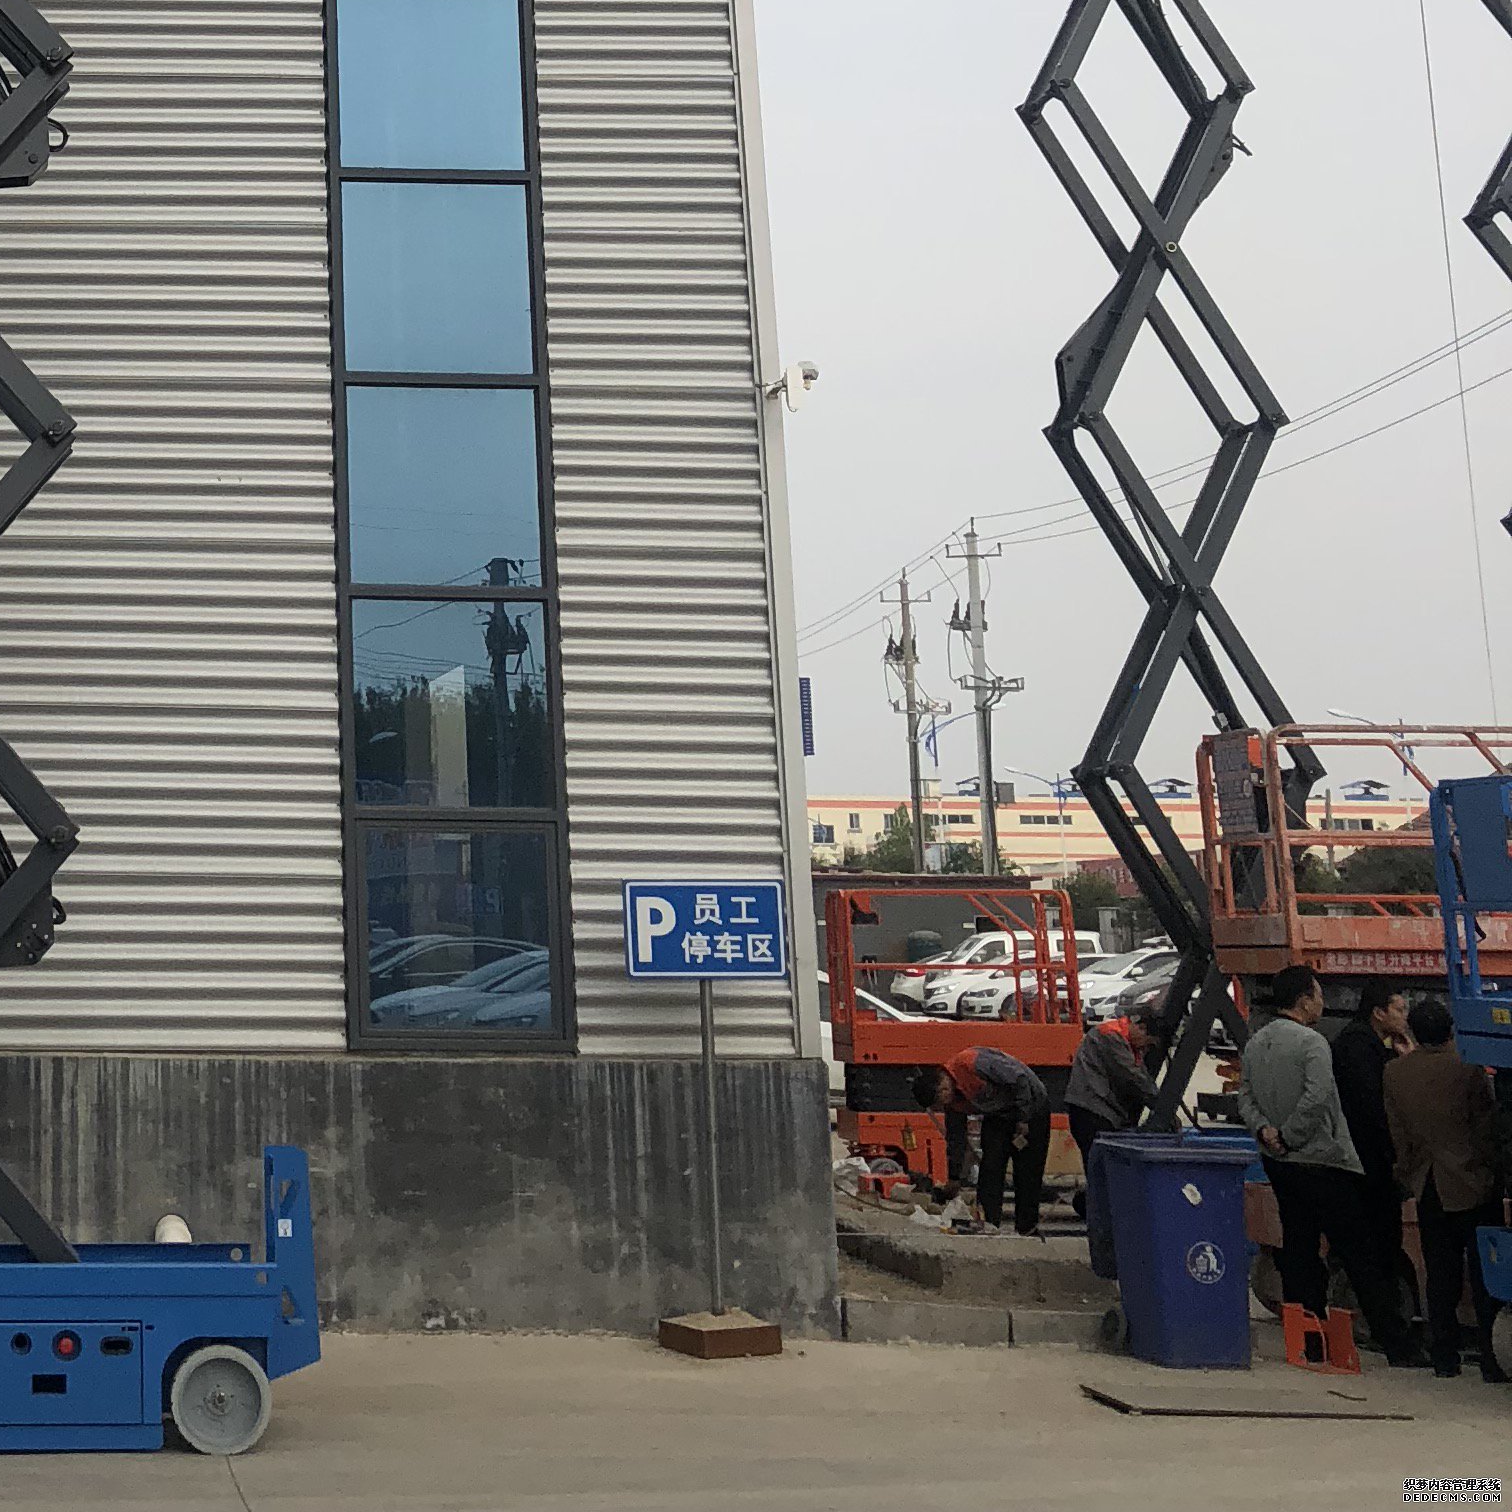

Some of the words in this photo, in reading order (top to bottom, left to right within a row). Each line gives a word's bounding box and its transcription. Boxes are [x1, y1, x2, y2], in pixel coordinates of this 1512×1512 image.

[693, 893, 760, 926] 员工
[635, 896, 677, 963] P
[681, 931, 775, 964] 停车区
